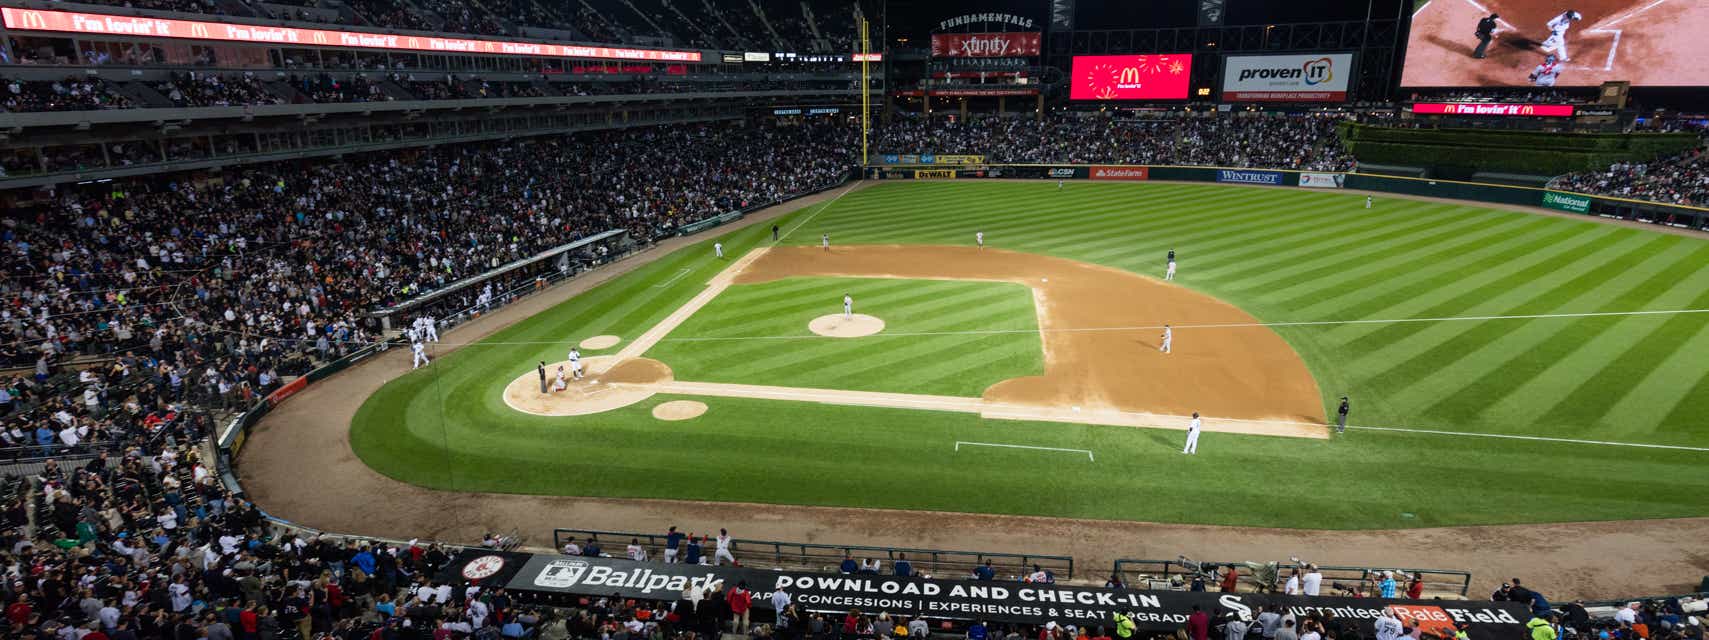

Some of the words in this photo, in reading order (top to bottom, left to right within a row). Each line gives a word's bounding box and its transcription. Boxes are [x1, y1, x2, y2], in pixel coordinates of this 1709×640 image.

[940, 13, 1033, 30] FUNDAMENTALS
[961, 36, 1010, 56] xfinity
[1239, 68, 1302, 82] proven
[1310, 66, 1326, 78] IT
[1222, 171, 1277, 182] WINTRUST
[1553, 194, 1589, 207] National
[582, 565, 724, 594] Ballpark
[776, 575, 940, 596] DOWNLOAD
[949, 585, 1009, 601] AND
[1018, 588, 1161, 608] CHECK-IN
[797, 594, 912, 609] CONCESSIONS
[929, 601, 1042, 616] EXPERIENCES
[1048, 606, 1059, 618] &
[1064, 608, 1106, 621] SEAT
[1394, 606, 1448, 622] Rate
[1445, 608, 1520, 624] Field
